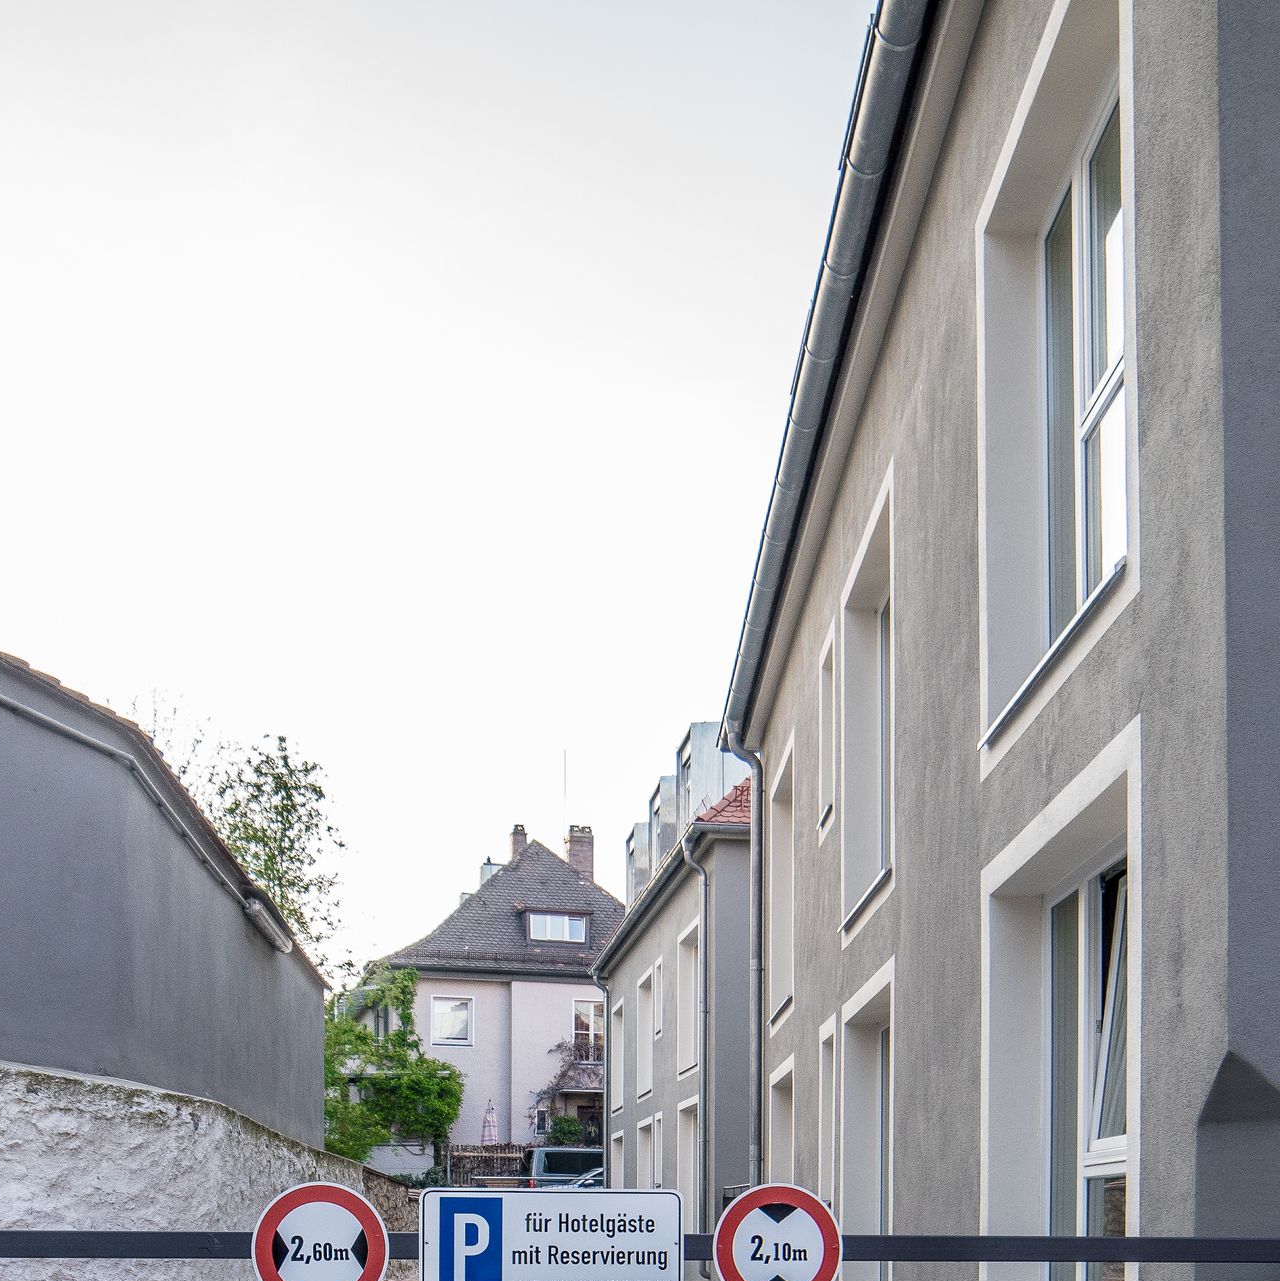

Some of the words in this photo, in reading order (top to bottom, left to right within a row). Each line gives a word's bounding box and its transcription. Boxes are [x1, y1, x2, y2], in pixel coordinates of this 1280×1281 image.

[524, 1212, 552, 1233] für
[558, 1212, 656, 1239] Hotelgäste
[290, 1235, 350, 1265] 2,60m
[511, 1244, 542, 1265] mit
[547, 1244, 668, 1271] Reservierung
[750, 1234, 808, 1265] 2,10m
